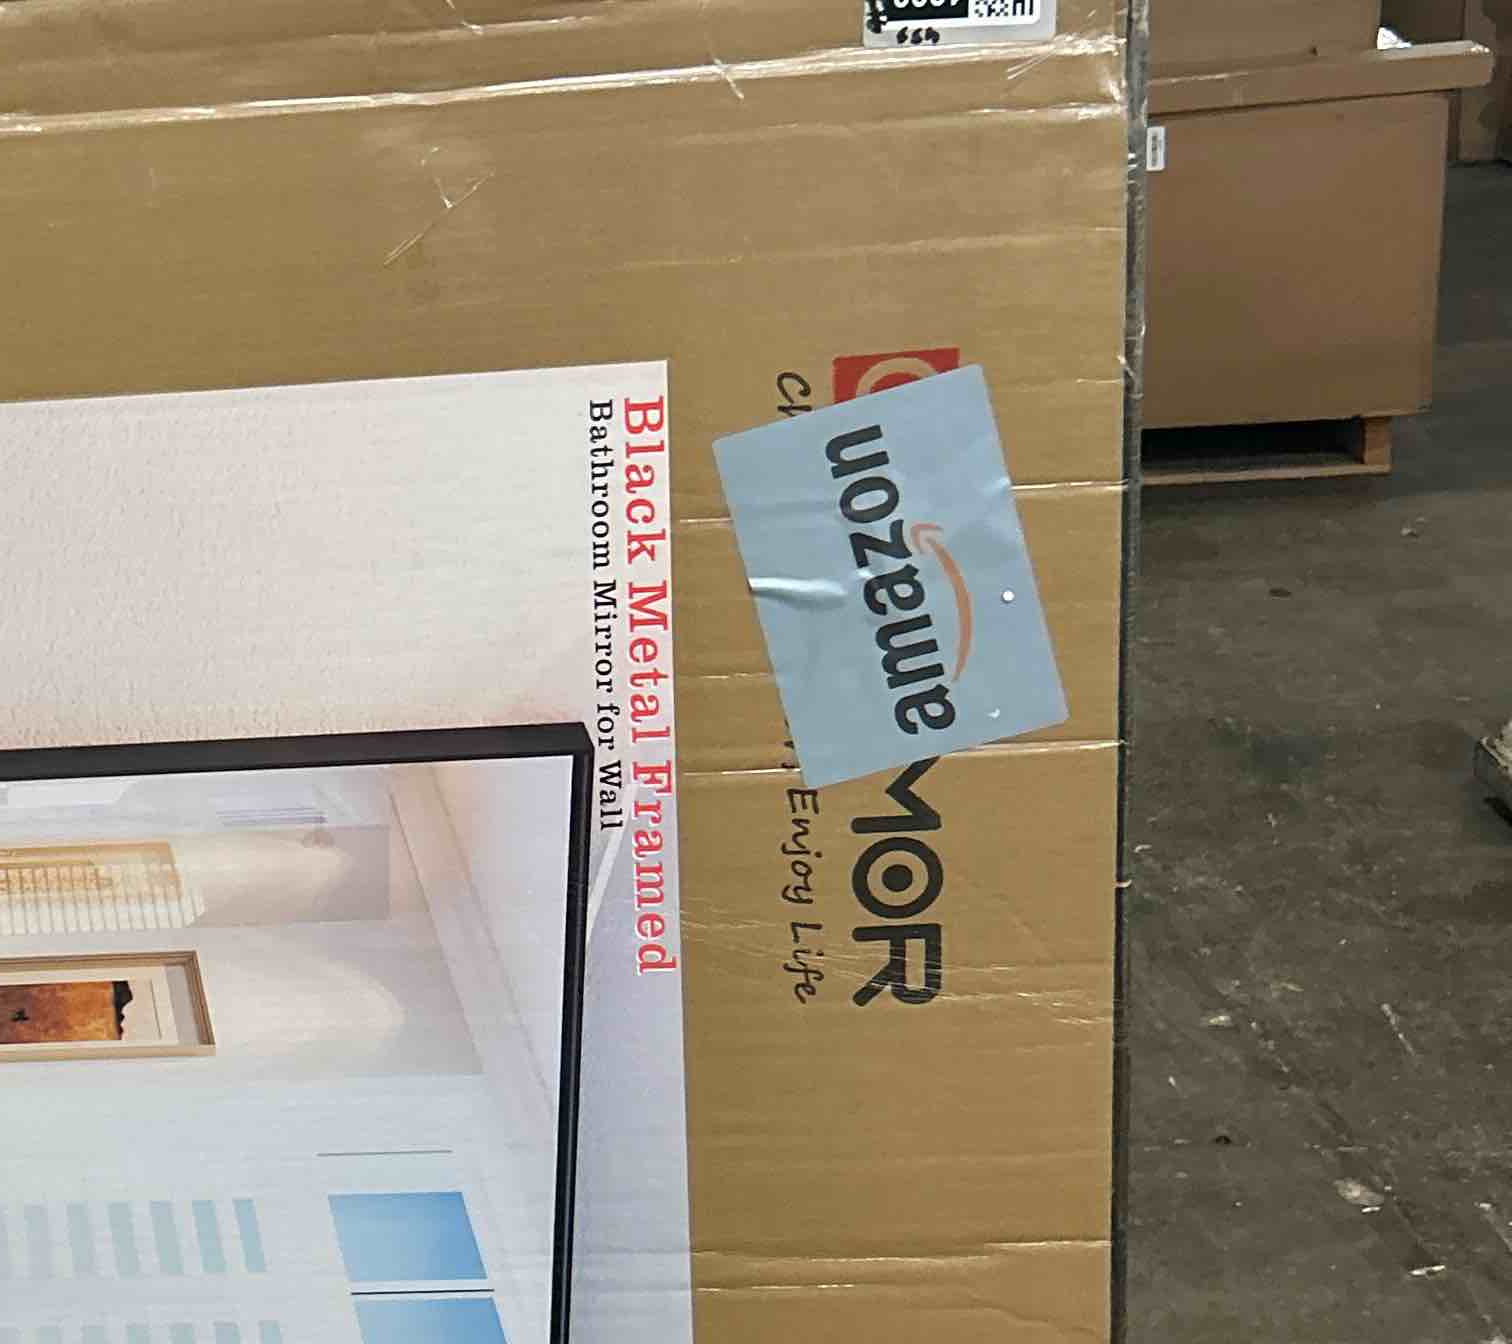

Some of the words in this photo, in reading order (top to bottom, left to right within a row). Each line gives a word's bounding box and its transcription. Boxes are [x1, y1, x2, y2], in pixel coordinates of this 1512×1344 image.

[589, 400, 621, 570] Bathroom
[624, 396, 666, 565] Black
[592, 580, 620, 694] Mirror
[825, 425, 956, 736] amazon
[596, 703, 622, 751] for
[627, 581, 670, 743] Metal
[598, 761, 623, 831] Wall
[781, 788, 819, 904] Enjoy
[631, 761, 676, 976] Framed
[783, 915, 824, 1006] Life
